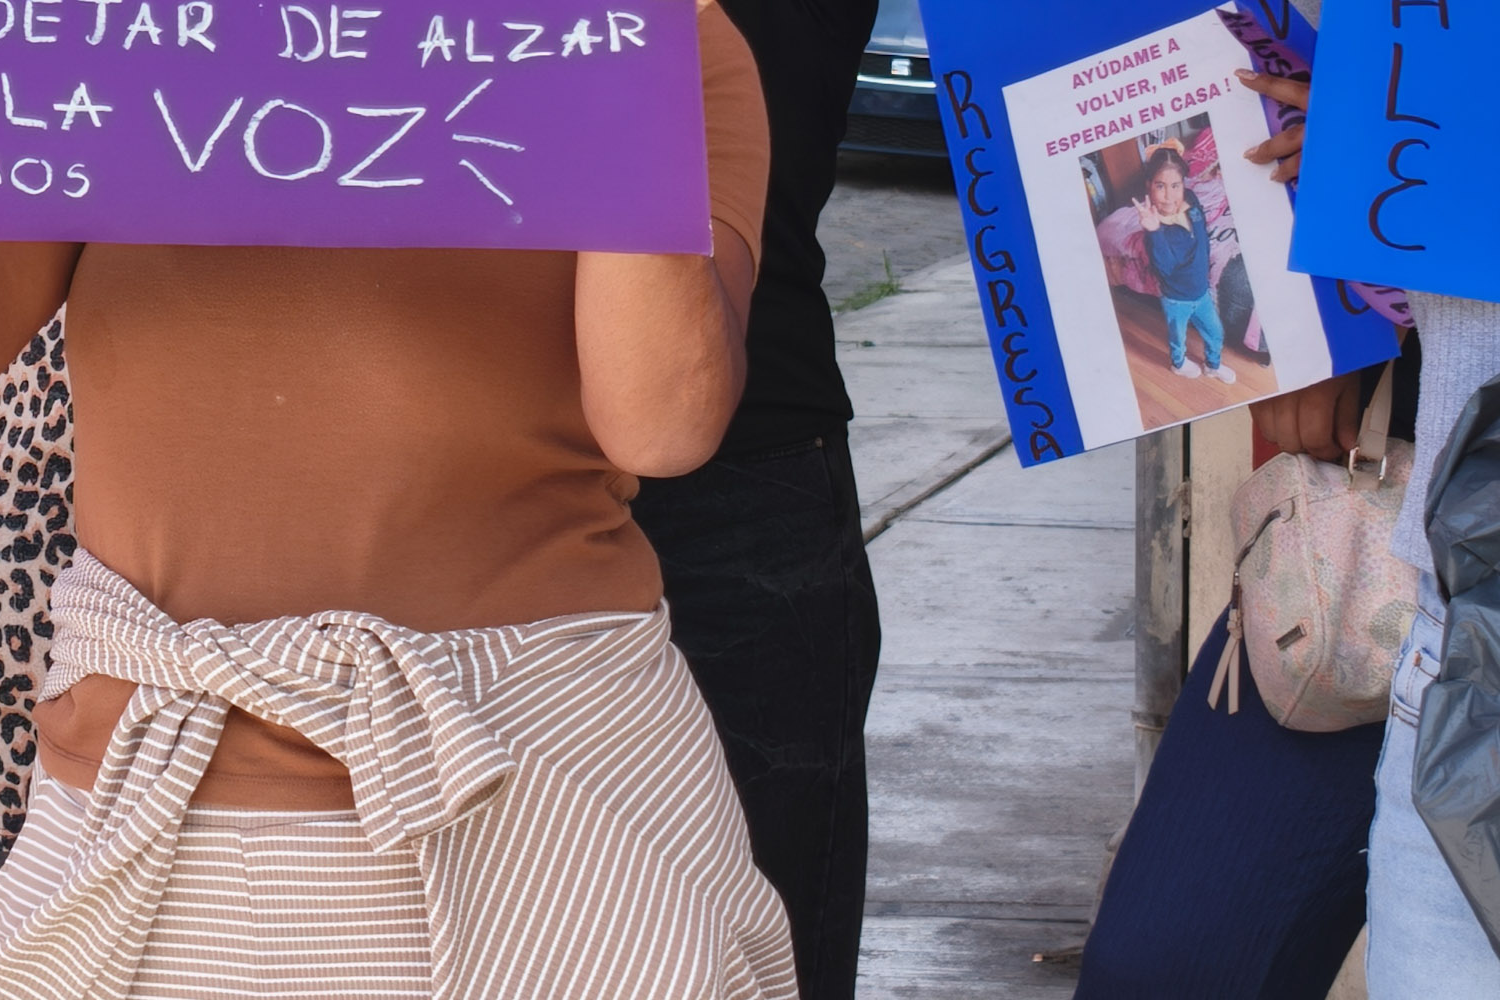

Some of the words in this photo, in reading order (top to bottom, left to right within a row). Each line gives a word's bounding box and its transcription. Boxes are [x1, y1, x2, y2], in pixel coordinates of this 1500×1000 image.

[278, 5, 382, 62] DE
[419, 9, 647, 65] ALZAR
[1071, 43, 1163, 90] AYÚDAME
[1167, 37, 1181, 55] A
[1045, 113, 1134, 158] ESPERAN
[1138, 102, 1166, 125] EN
[1170, 82, 1222, 113] CASA
[1075, 77, 1158, 117] VOLVER,
[1160, 63, 1190, 87] ME
[3, 71, 115, 131] LA
[153, 87, 428, 189] VOZ
[942, 69, 1066, 462] REGRESA
